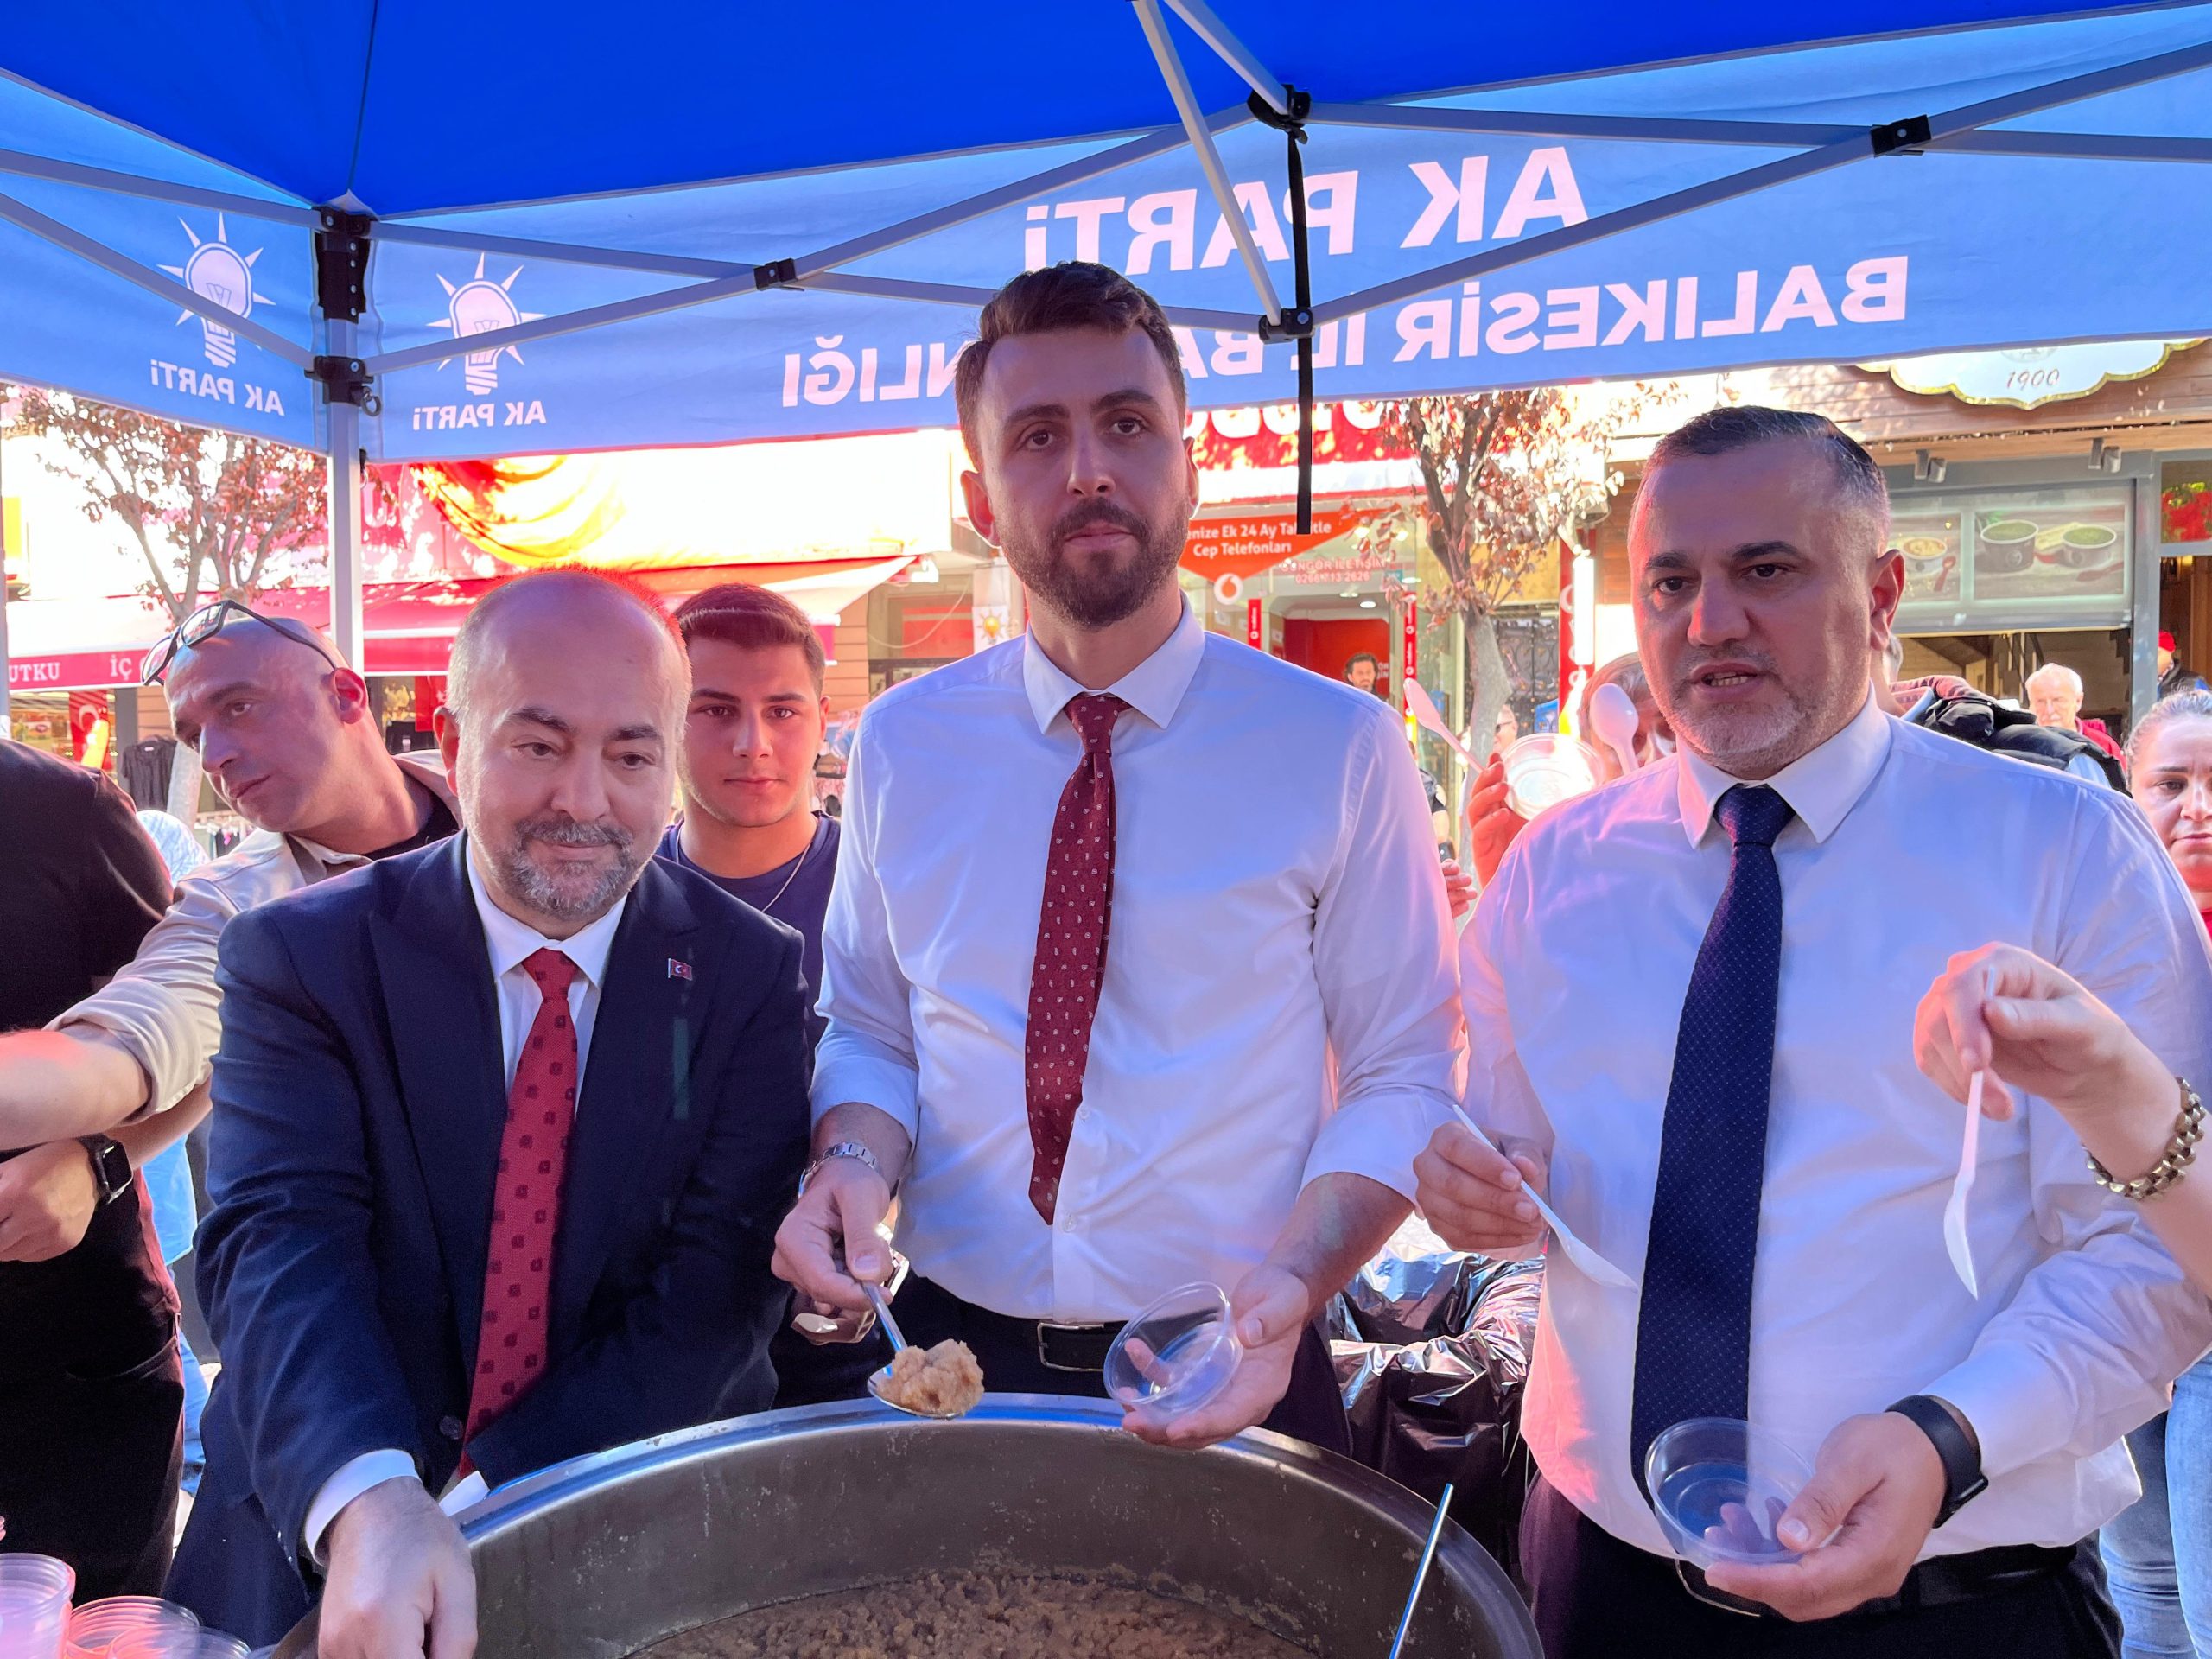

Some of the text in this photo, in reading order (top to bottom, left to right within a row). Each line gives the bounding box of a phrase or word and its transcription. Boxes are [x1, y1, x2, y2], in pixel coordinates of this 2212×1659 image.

[2006, 368, 2060, 391] 1900
[1222, 524, 1237, 538] Ek
[1240, 523, 1257, 537] 24
[1259, 523, 1277, 540] Ay
[1193, 540, 1292, 559] Cep Telefonları
[110, 654, 132, 680] İÇ
